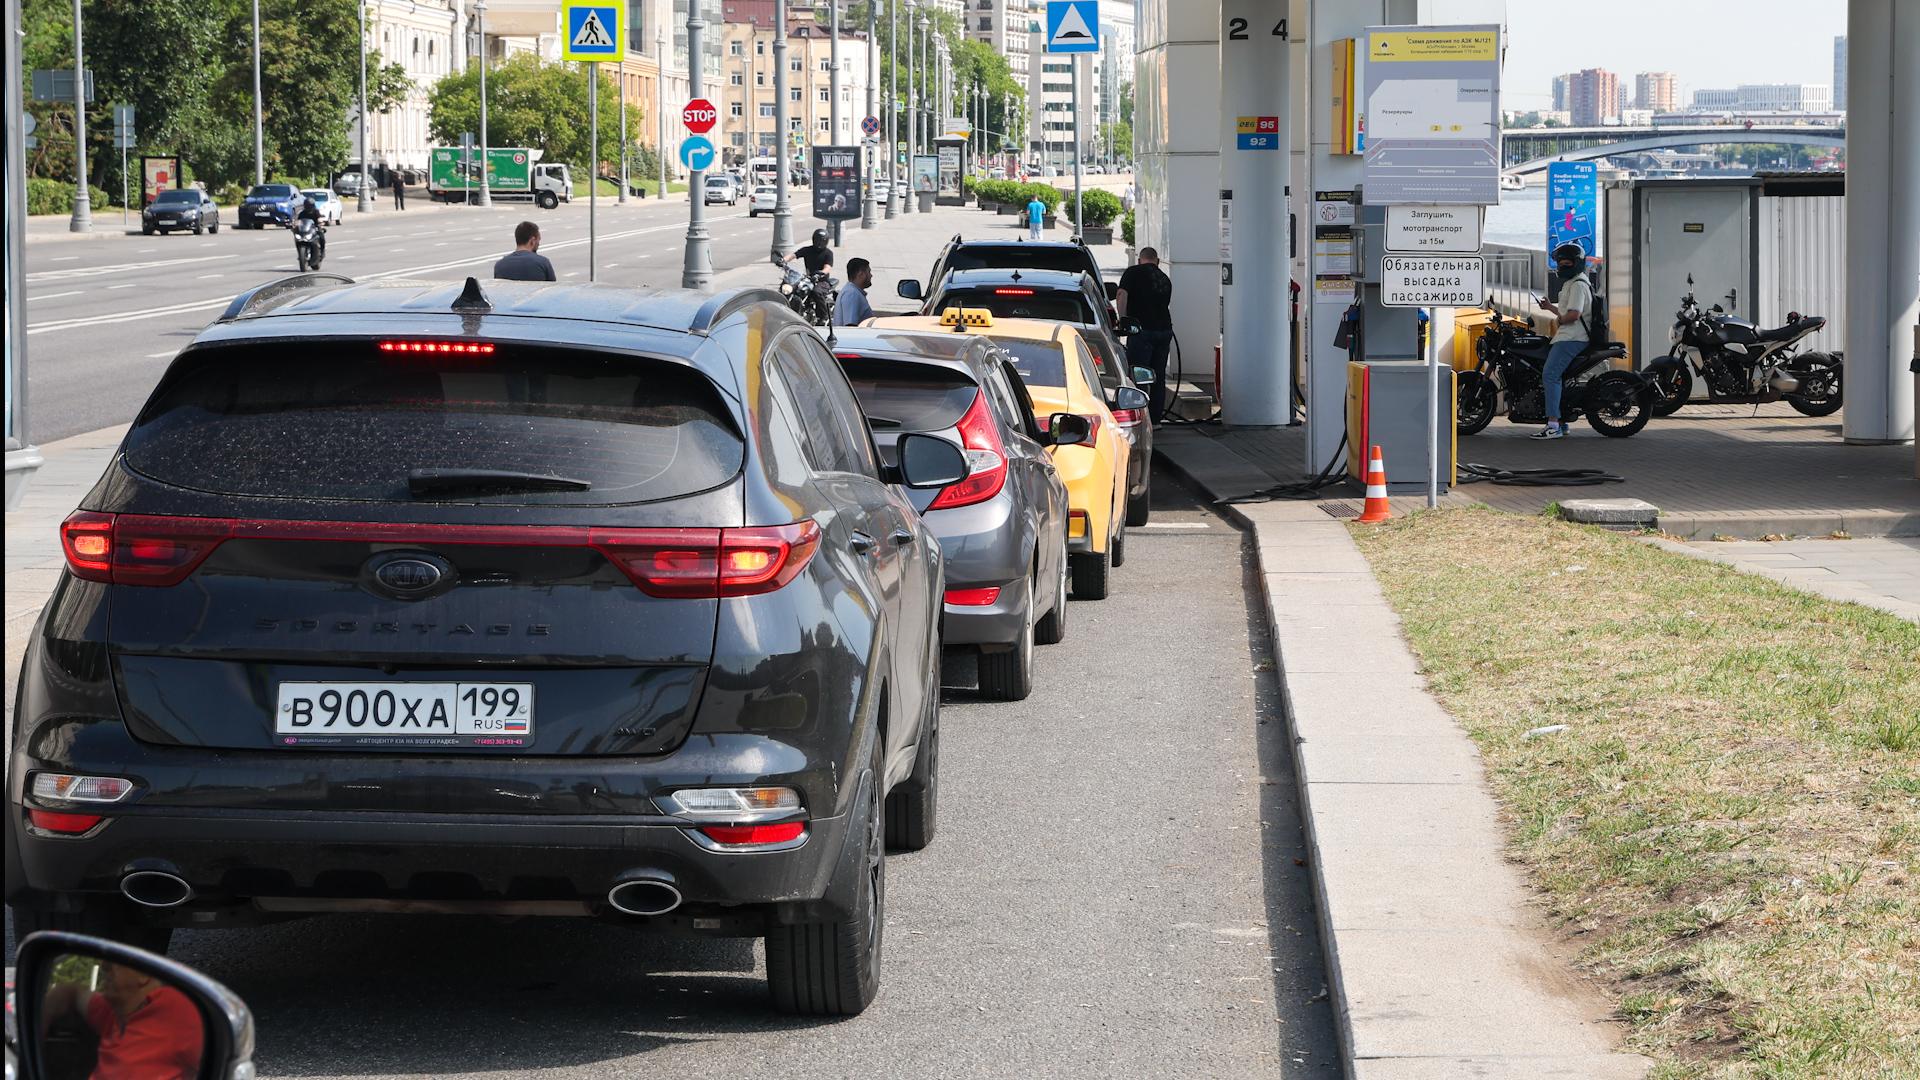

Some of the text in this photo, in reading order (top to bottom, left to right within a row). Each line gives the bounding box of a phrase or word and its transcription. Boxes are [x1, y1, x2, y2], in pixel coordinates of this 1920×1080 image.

[1229, 18, 1289, 41] 2 4
[684, 110, 715, 122] STOP
[1260, 120, 1275, 129] 95
[1249, 137, 1267, 146] 92
[1411, 210, 1454, 220] Заглушить
[1385, 258, 1480, 271] Обязательная
[1404, 277, 1461, 287] высадка
[1391, 292, 1473, 304] пассажиров
[386, 566, 430, 585] KIA
[254, 618, 553, 637] SPORTAGE
[462, 687, 521, 717] 199
[474, 719, 503, 730] RUS
